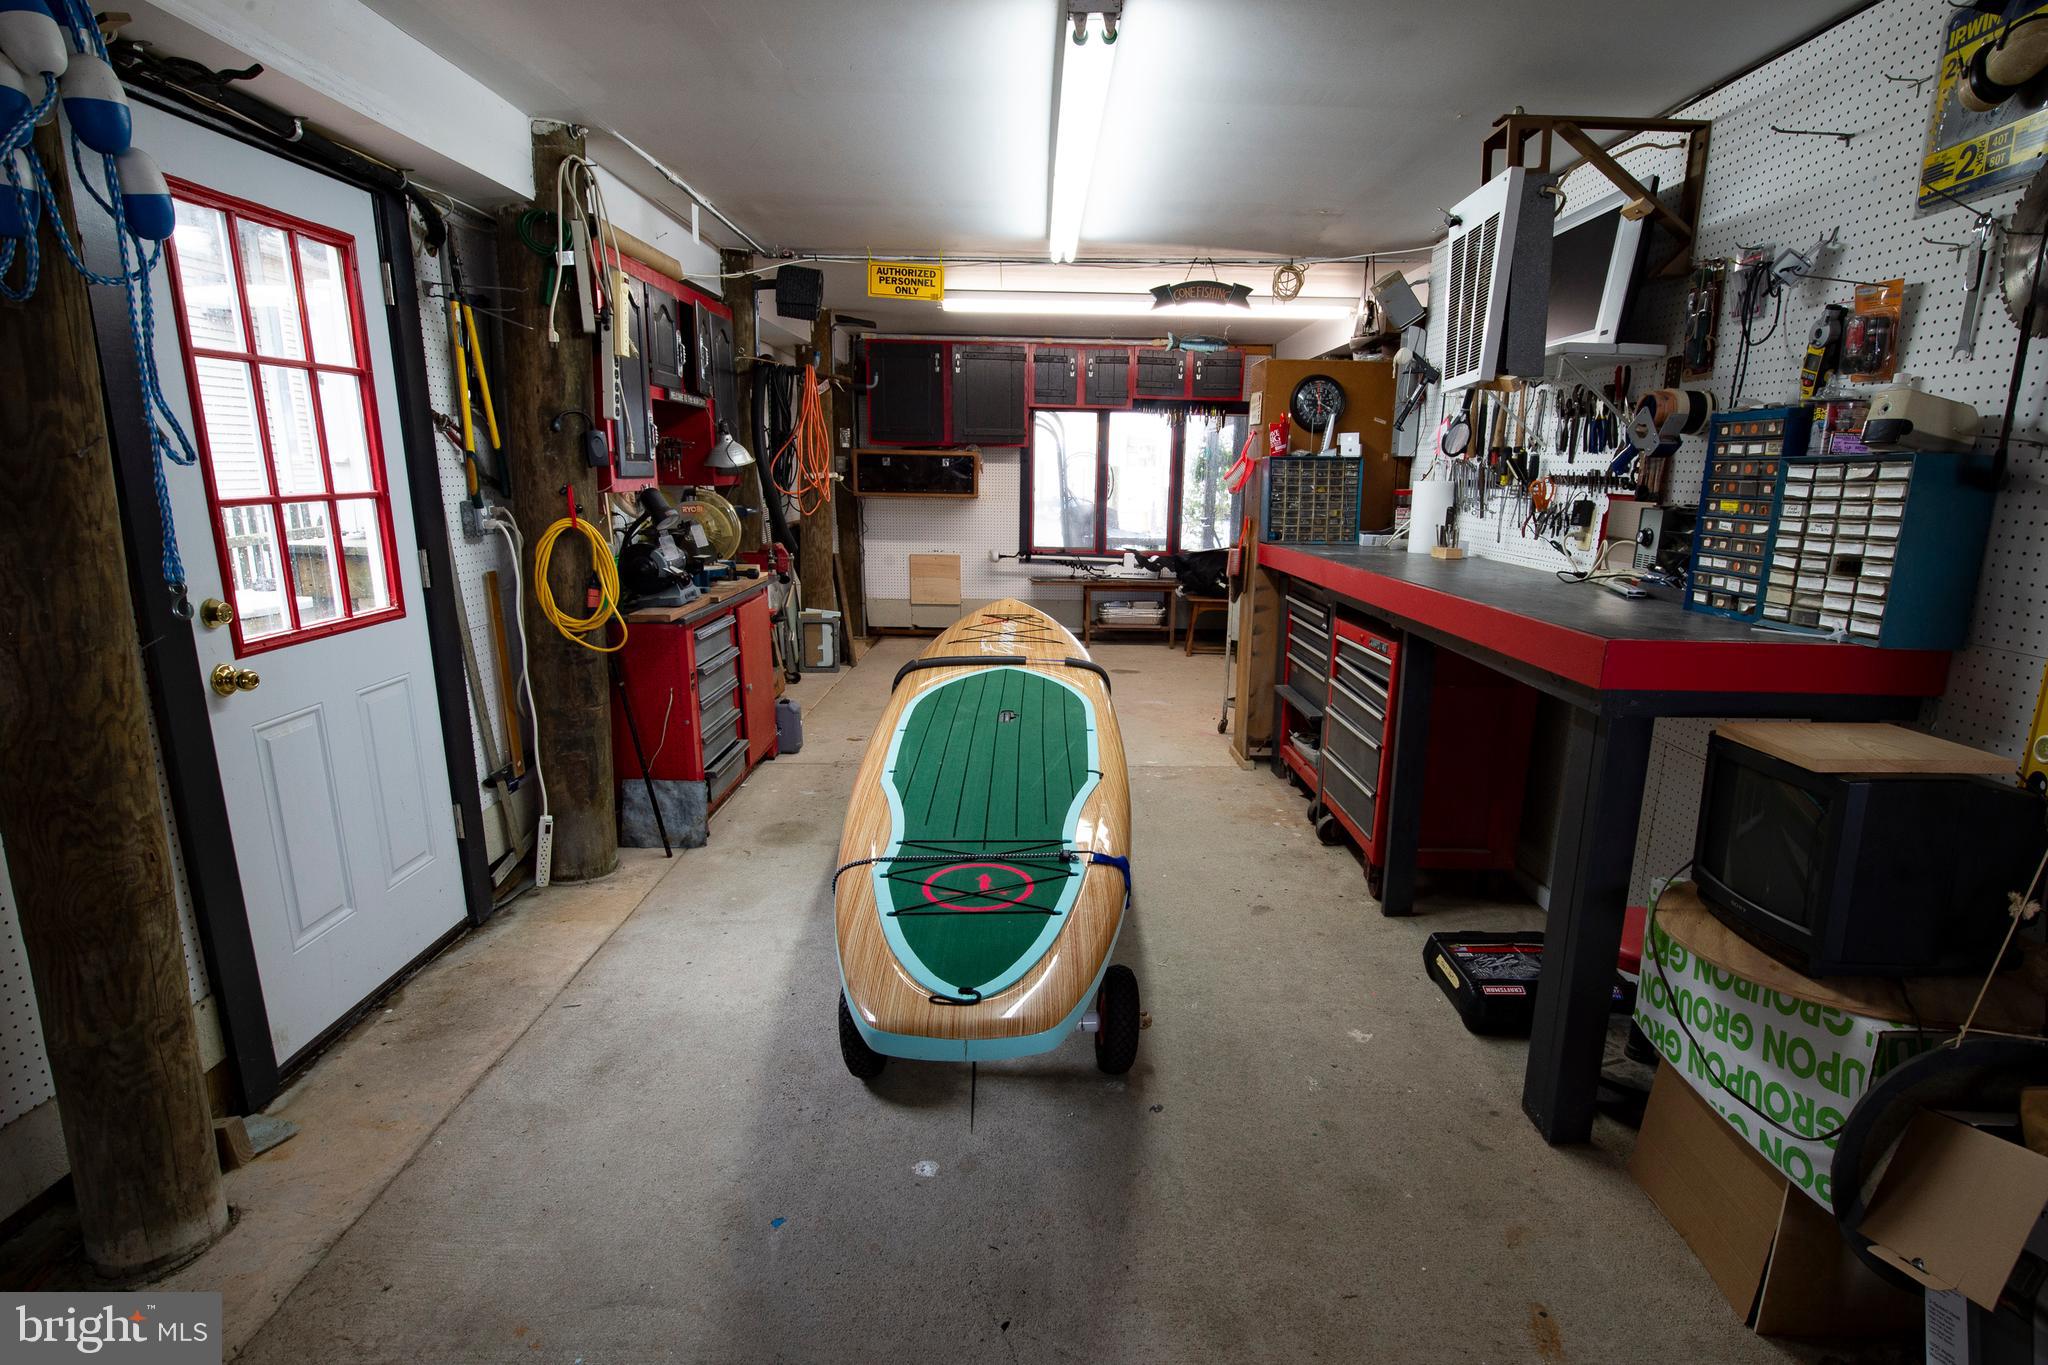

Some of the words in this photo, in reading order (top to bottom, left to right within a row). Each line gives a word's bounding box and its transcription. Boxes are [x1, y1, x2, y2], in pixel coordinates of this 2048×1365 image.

[1948, 13, 2003, 50] IRWIN
[1955, 143, 1978, 181] 2
[876, 266, 937, 279] AUTHORIZED
[878, 275, 936, 288] PERSONNEL
[894, 286, 919, 295] ONLY
[681, 505, 703, 513] RYOBI
[1730, 900, 1747, 913] SONY
[1641, 972, 1754, 1051] GROUPON
[1762, 1024, 1867, 1098] UPON
[1688, 1040, 1848, 1150] GROUPON
